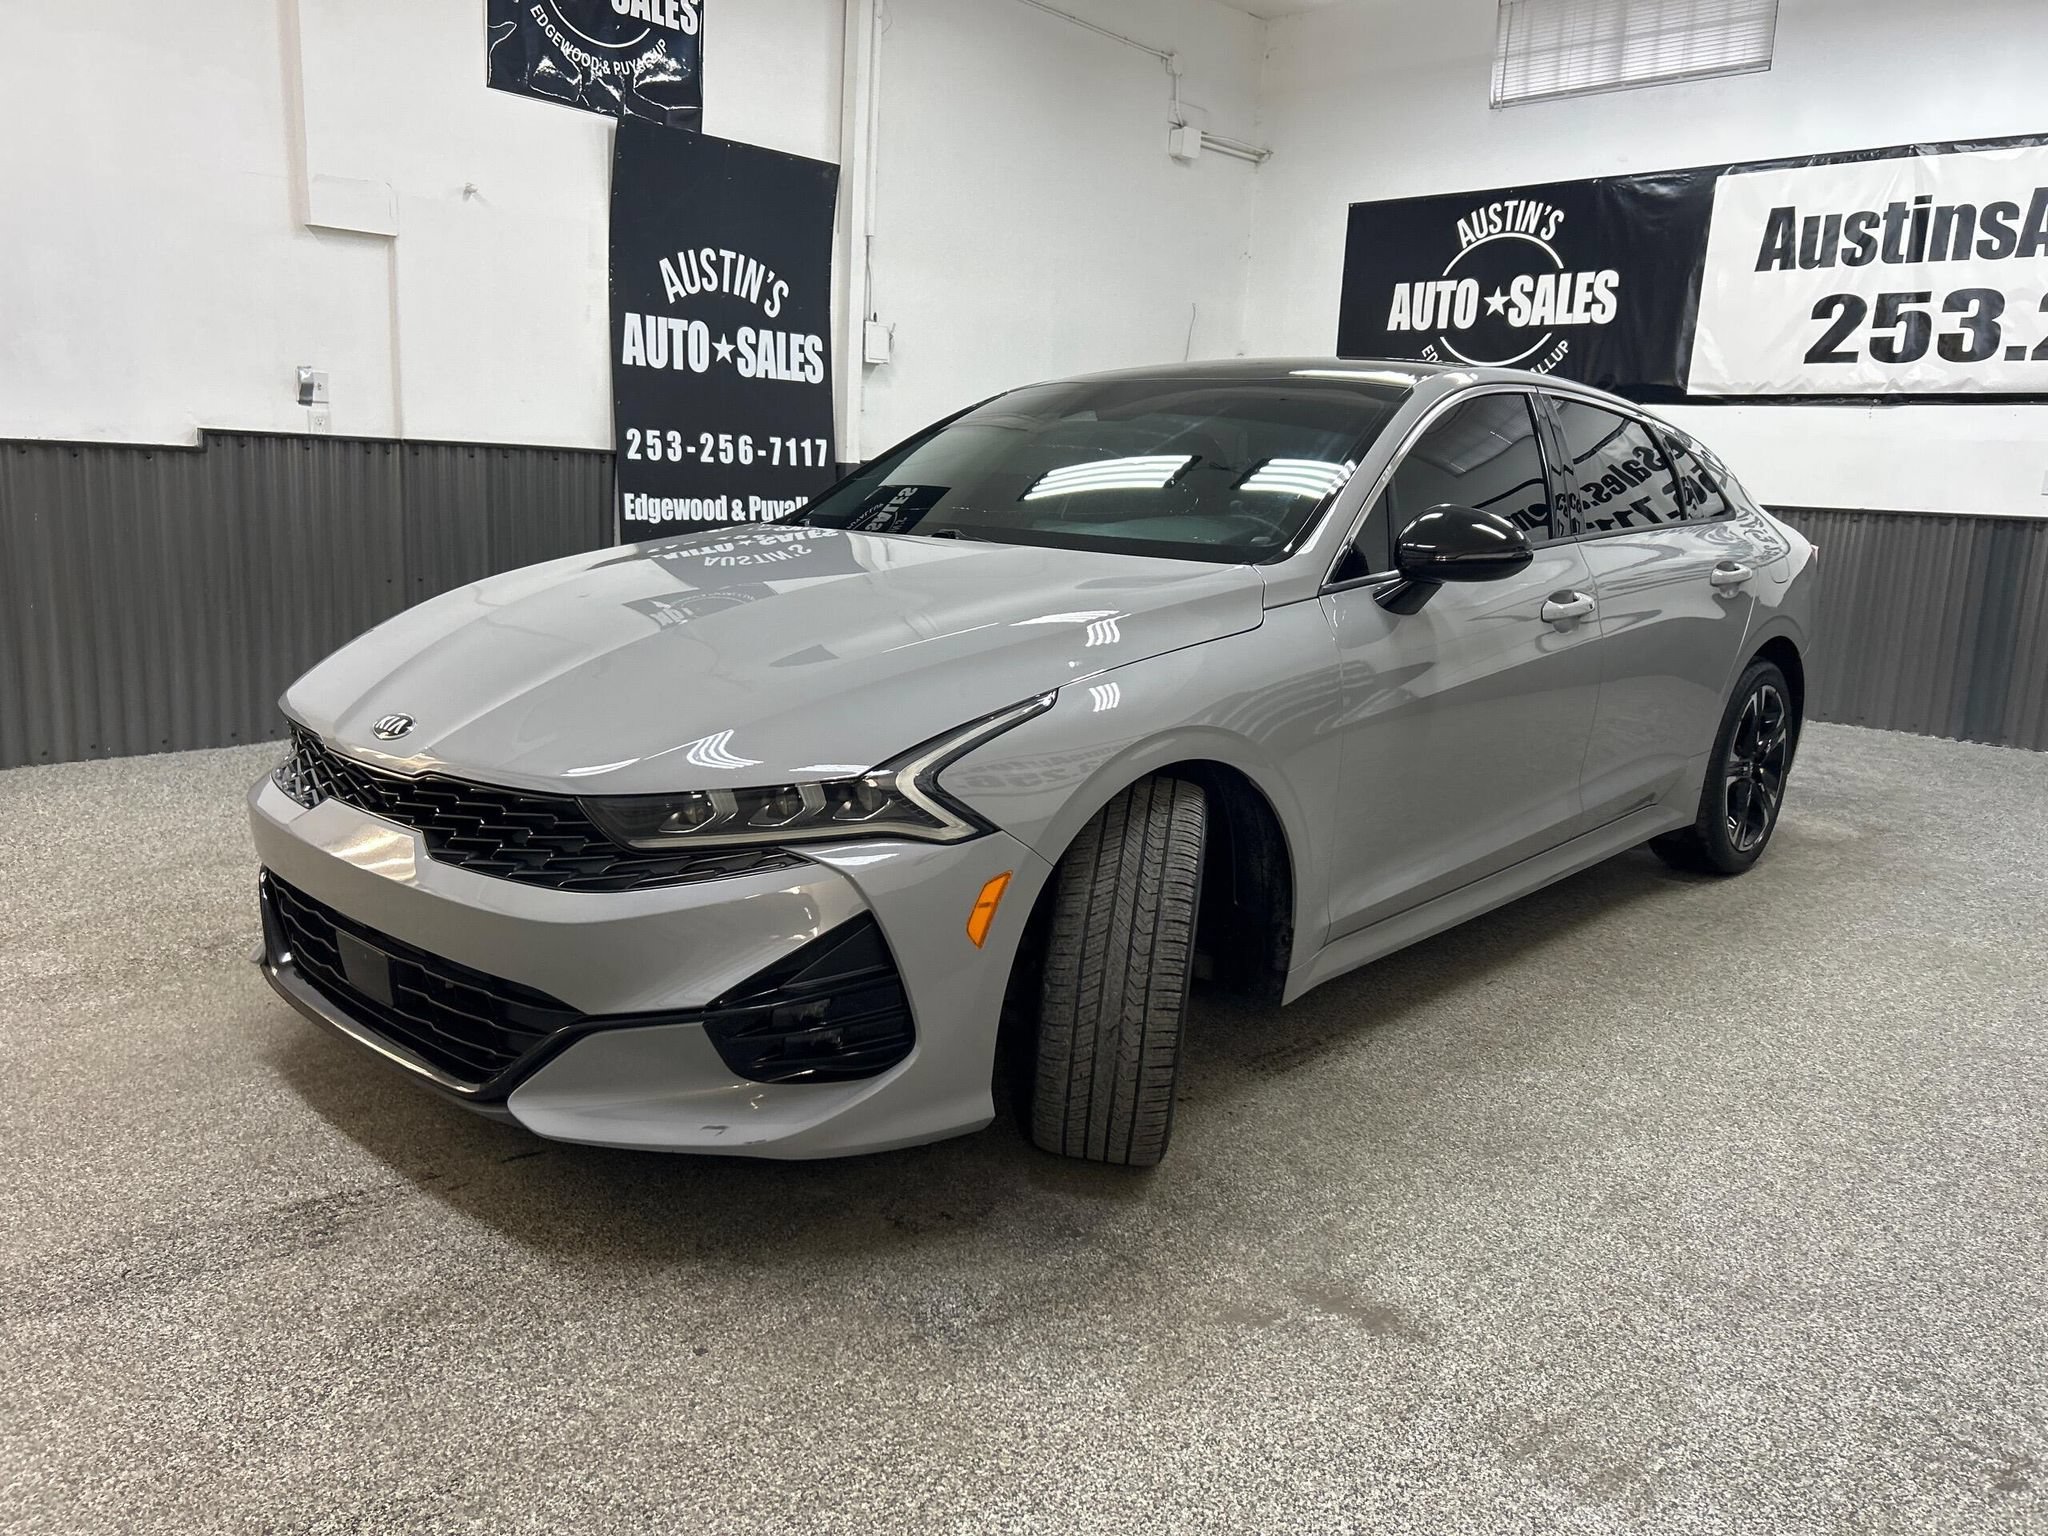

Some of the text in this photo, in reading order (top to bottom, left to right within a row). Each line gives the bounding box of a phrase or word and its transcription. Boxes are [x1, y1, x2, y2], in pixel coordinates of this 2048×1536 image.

[613, 39, 667, 76] PUYAUP
[1456, 199, 1565, 249] AUSTIN'S
[658, 247, 790, 318] AUSTIN'S
[1386, 269, 1620, 332] AUTO SALES
[622, 312, 825, 385] AUTO SALES
[1803, 287, 2048, 365] 253.
[626, 428, 828, 467] 253-256-7117
[624, 493, 728, 524] Edgewood
[731, 499, 747, 522] &
